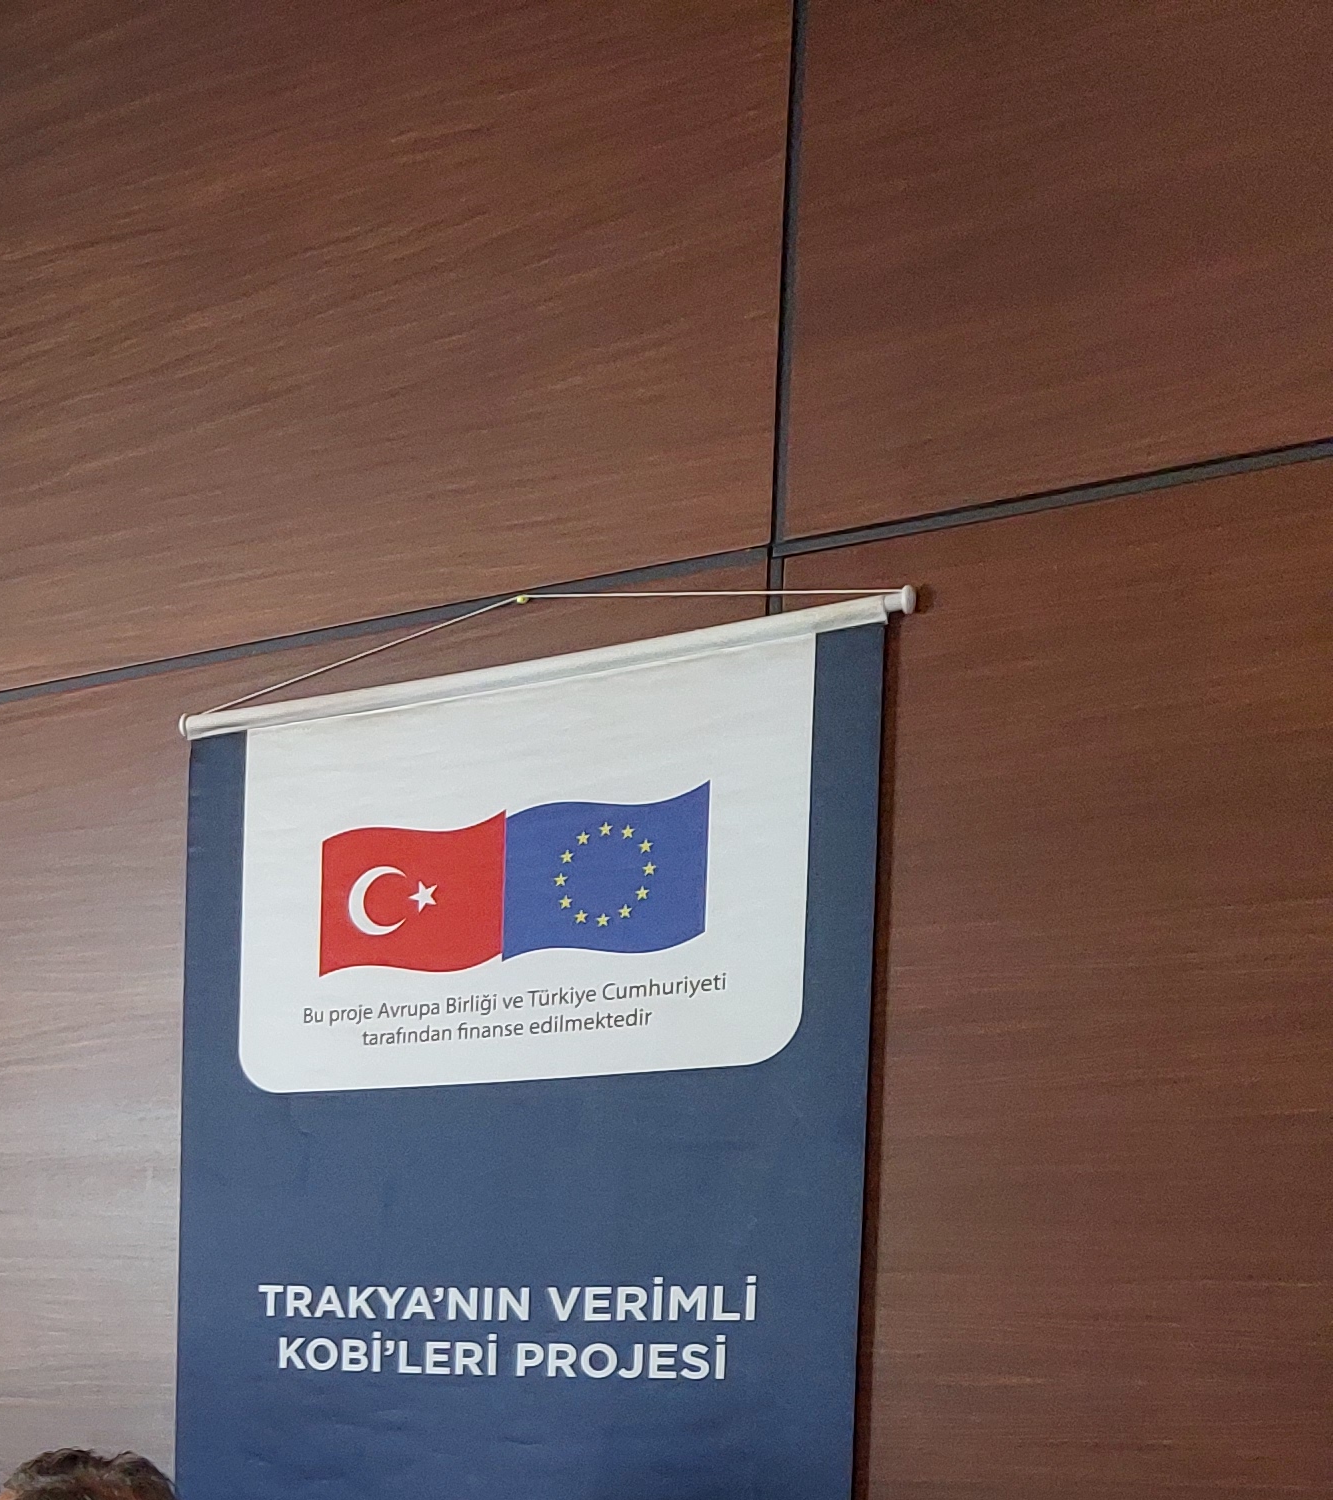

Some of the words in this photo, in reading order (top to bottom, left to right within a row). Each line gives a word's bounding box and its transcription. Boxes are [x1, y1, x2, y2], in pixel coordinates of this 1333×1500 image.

[303, 1007, 324, 1024] Bu
[329, 1004, 373, 1026] proje
[377, 1002, 440, 1020] Avrupa
[446, 993, 498, 1016] Birliği
[502, 995, 524, 1009] ve
[527, 986, 597, 1009] Türkiye
[602, 972, 727, 1001] Cumhuriyeti
[362, 1025, 452, 1046] tarafından
[458, 1021, 524, 1039] finanse
[529, 1008, 653, 1035] edilmektedir
[258, 1284, 531, 1322] TRAKYA’NIN
[547, 1275, 757, 1322] VERİMLİ
[277, 1331, 498, 1378] KOBİ’LERİ
[516, 1334, 727, 1380] PROJESİ
